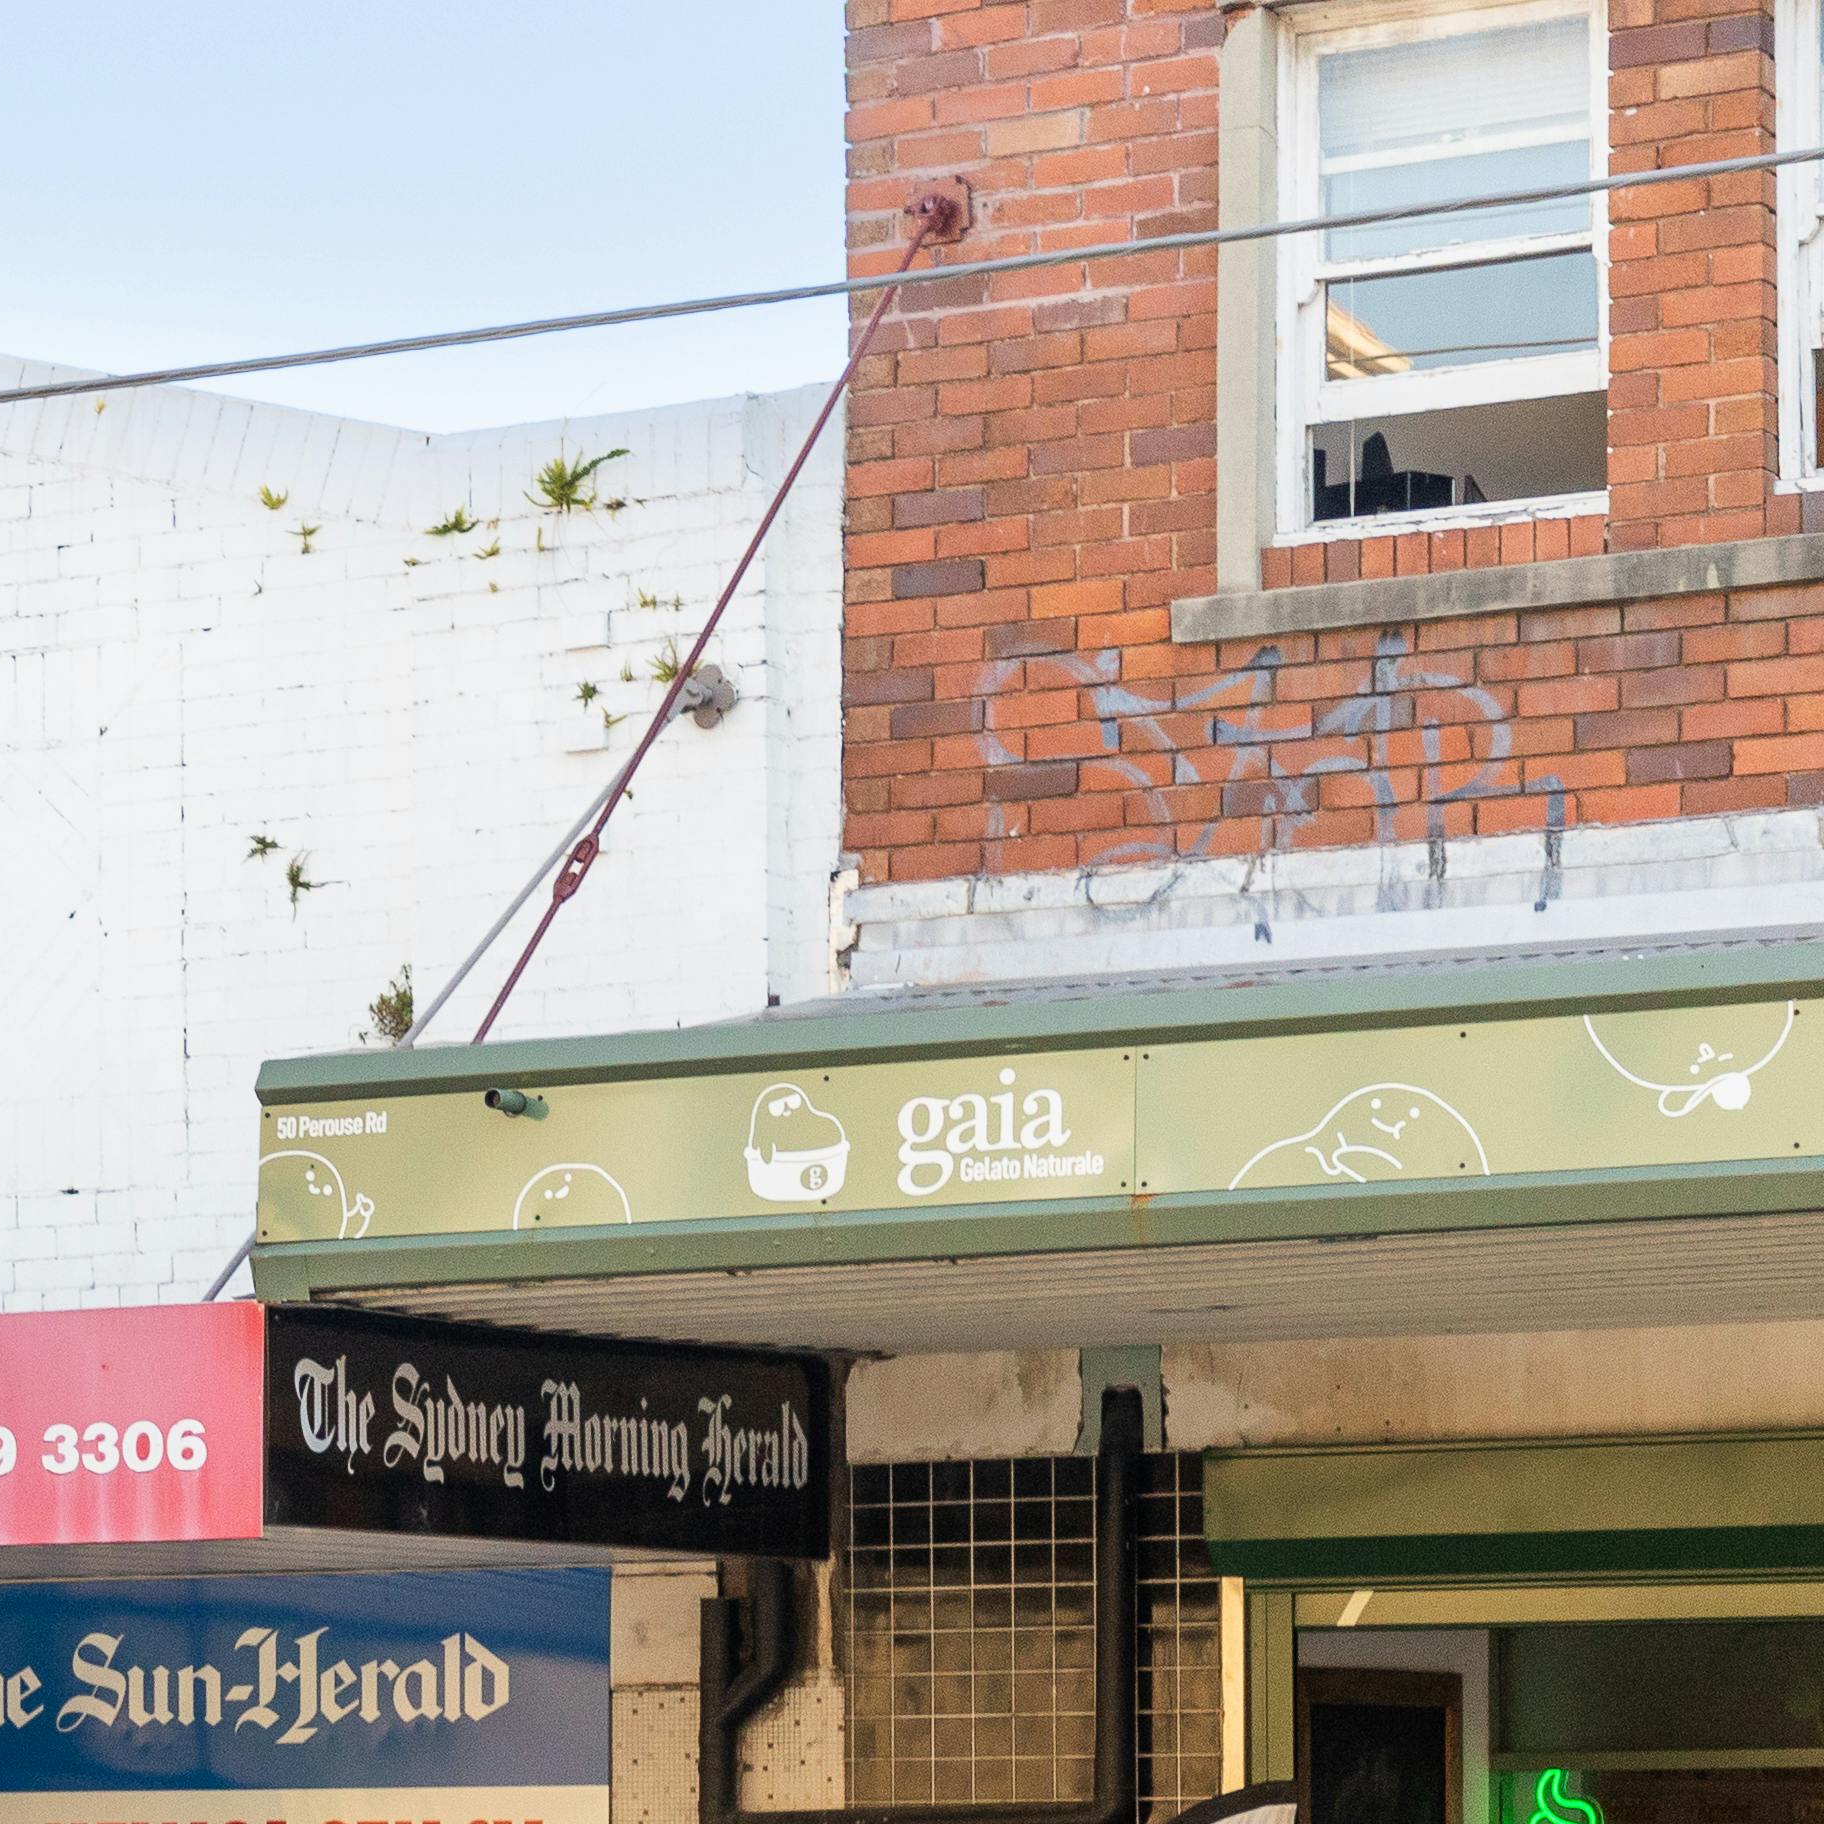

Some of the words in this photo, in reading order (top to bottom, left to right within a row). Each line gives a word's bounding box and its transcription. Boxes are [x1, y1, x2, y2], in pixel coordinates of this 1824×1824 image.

[276, 1116, 297, 1140] 50
[298, 1115, 364, 1139] Perouse
[365, 1111, 388, 1134] Rd
[897, 1067, 1072, 1197] gaia
[960, 1155, 1020, 1183] Gelato
[1024, 1150, 1104, 1179] Naturale
[40, 1417, 208, 1475] 3306
[294, 1355, 376, 1475] The
[383, 1362, 526, 1491] Sydney
[540, 1378, 690, 1502] Morning
[698, 1393, 809, 1507] Herald
[55, 1625, 510, 1745] Sun-Herald
